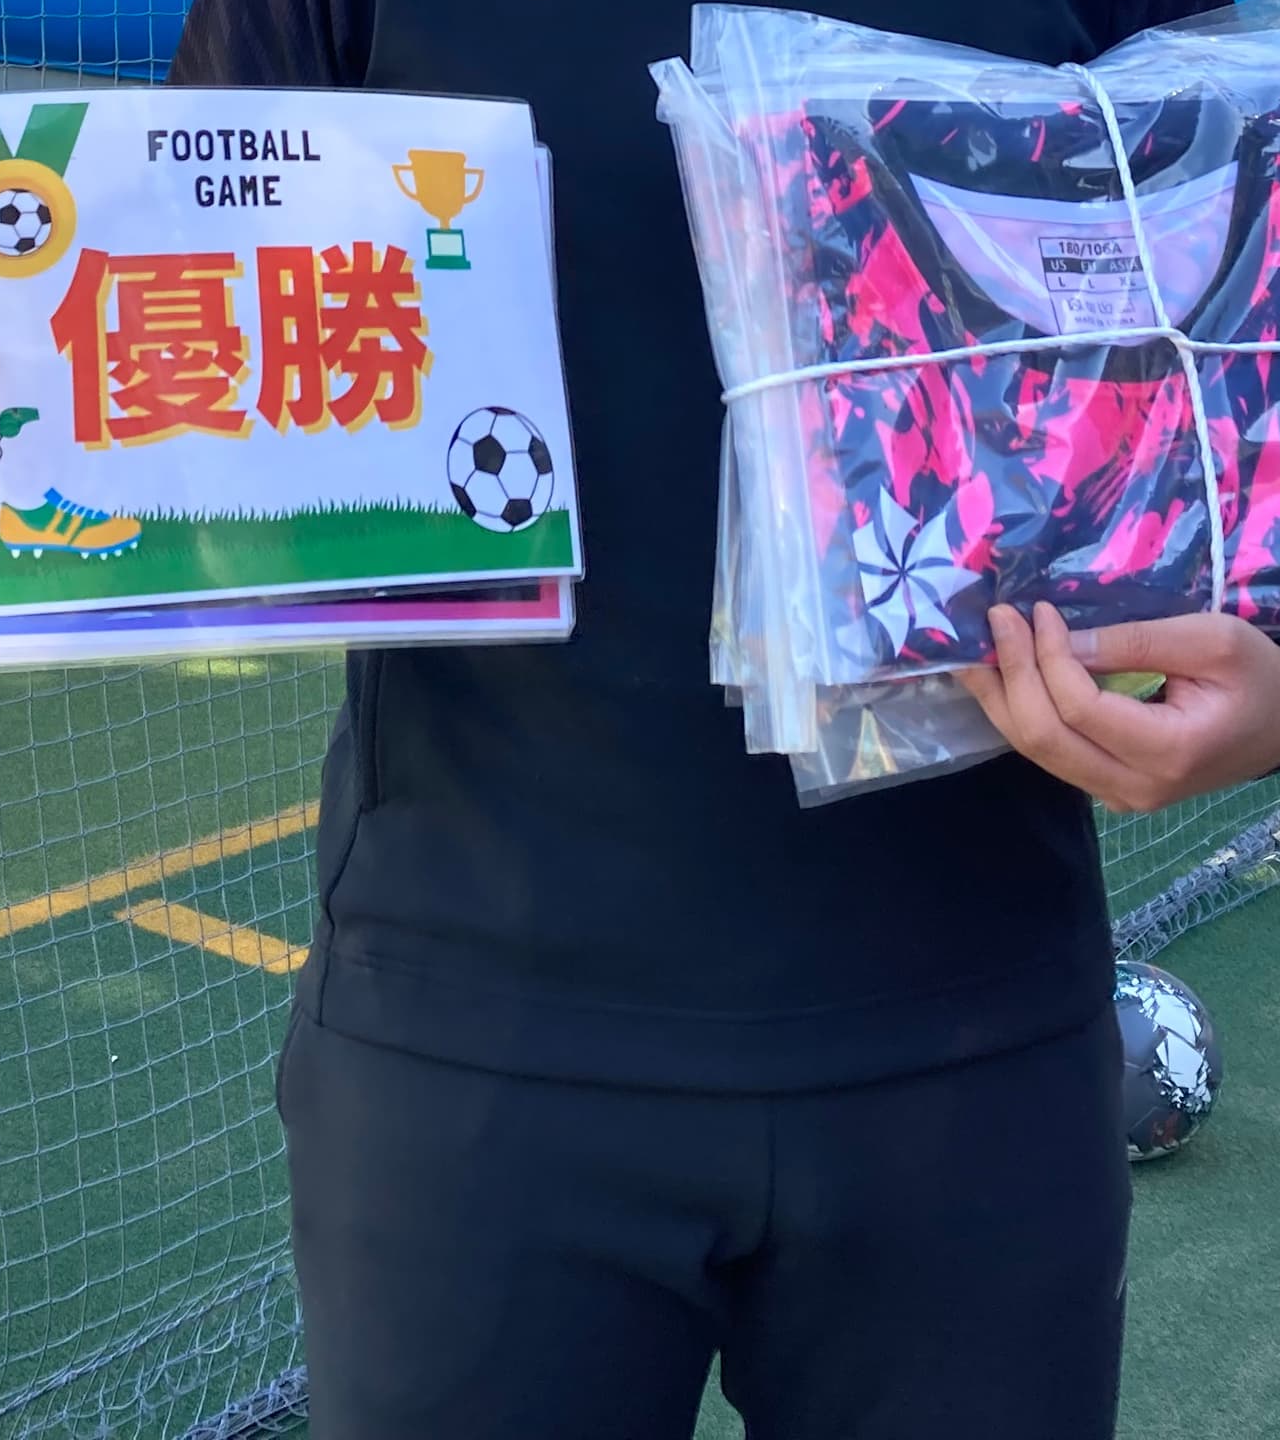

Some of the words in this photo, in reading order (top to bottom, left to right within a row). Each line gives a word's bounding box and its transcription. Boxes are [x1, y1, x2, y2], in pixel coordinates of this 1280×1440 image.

[146, 128, 322, 162] FOOTBALL
[194, 174, 283, 208] GAME
[1050, 259, 1067, 272] US
[1058, 276, 1066, 288] L
[1087, 278, 1095, 289] L
[50, 241, 434, 450] 優勝
